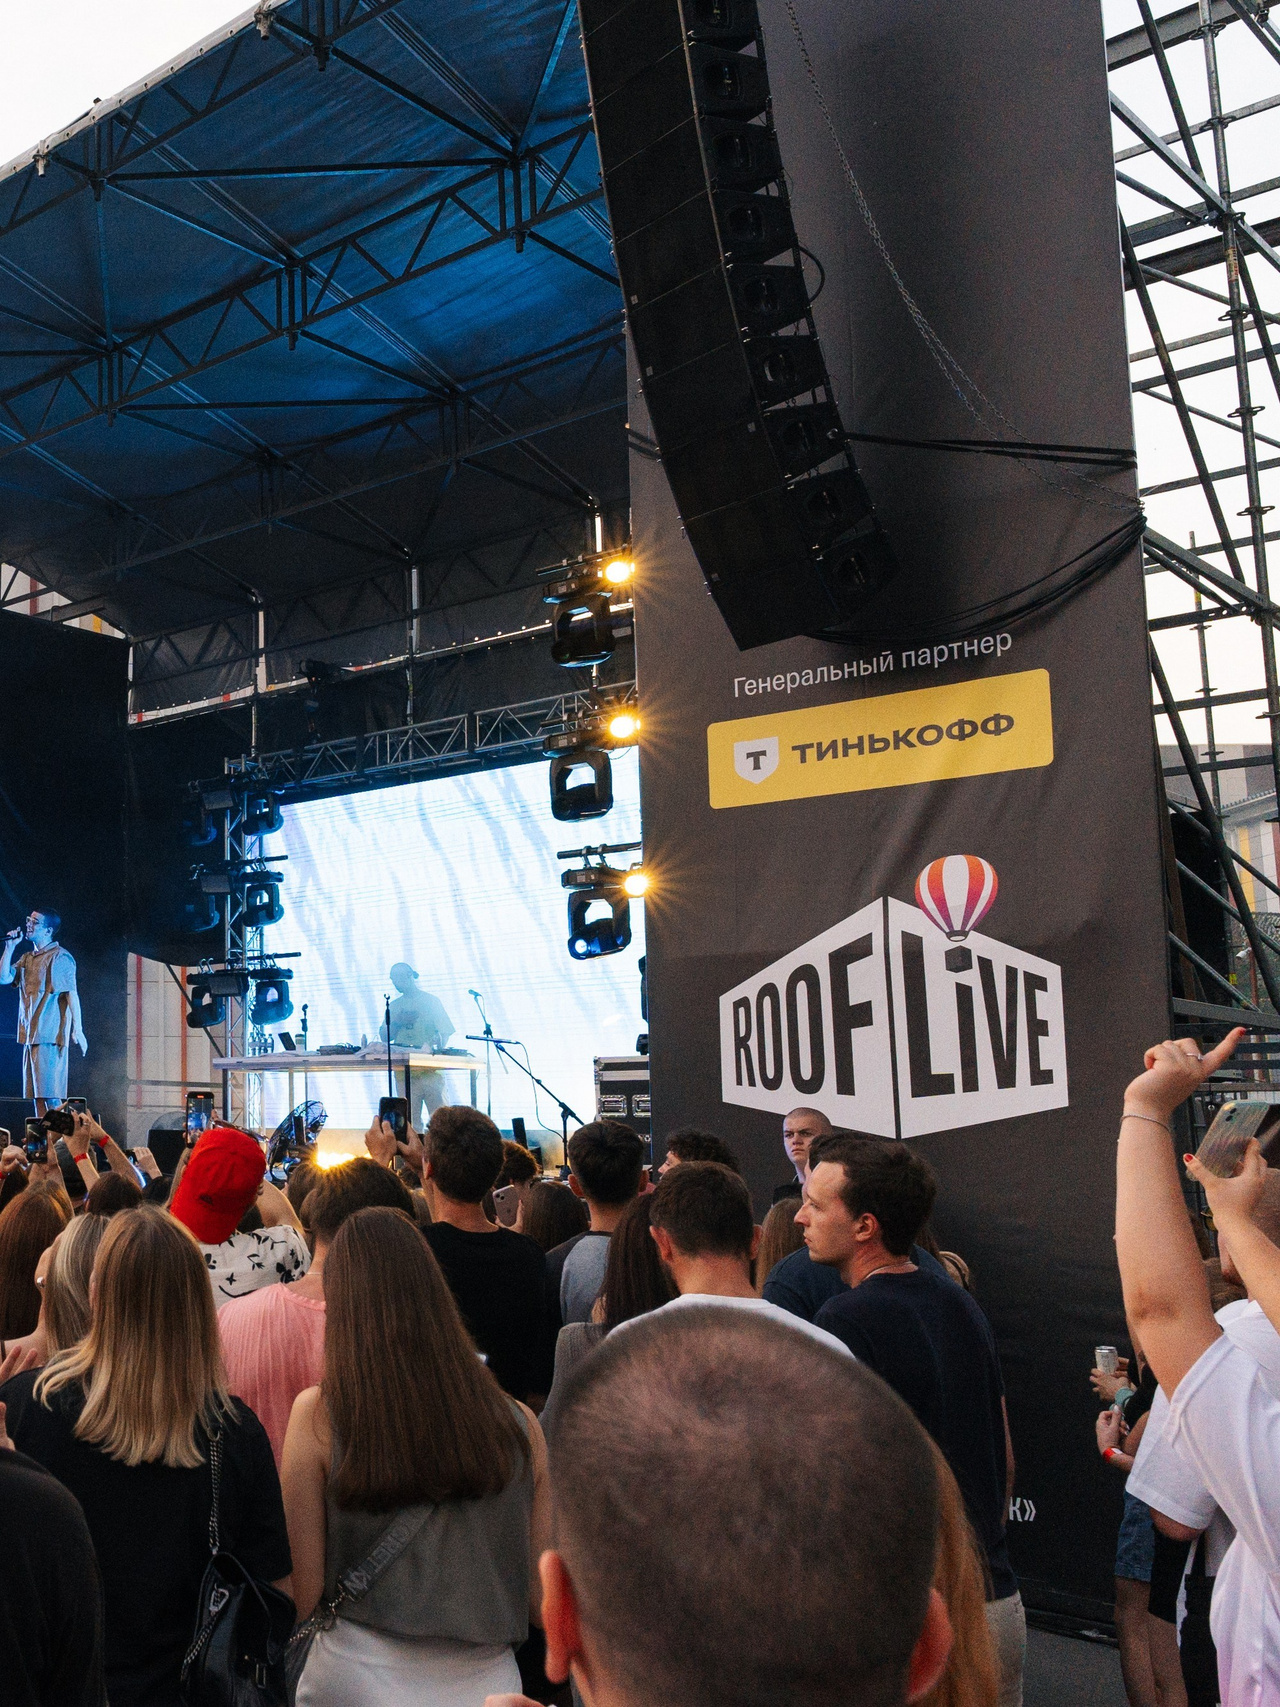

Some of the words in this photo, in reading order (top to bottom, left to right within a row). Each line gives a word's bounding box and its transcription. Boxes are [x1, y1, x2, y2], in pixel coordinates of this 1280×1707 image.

[733, 651, 895, 698] Генеральный
[902, 632, 1013, 670] партнер
[791, 712, 1015, 765] ТИНЬКОФФ
[732, 932, 874, 1097] ROOF
